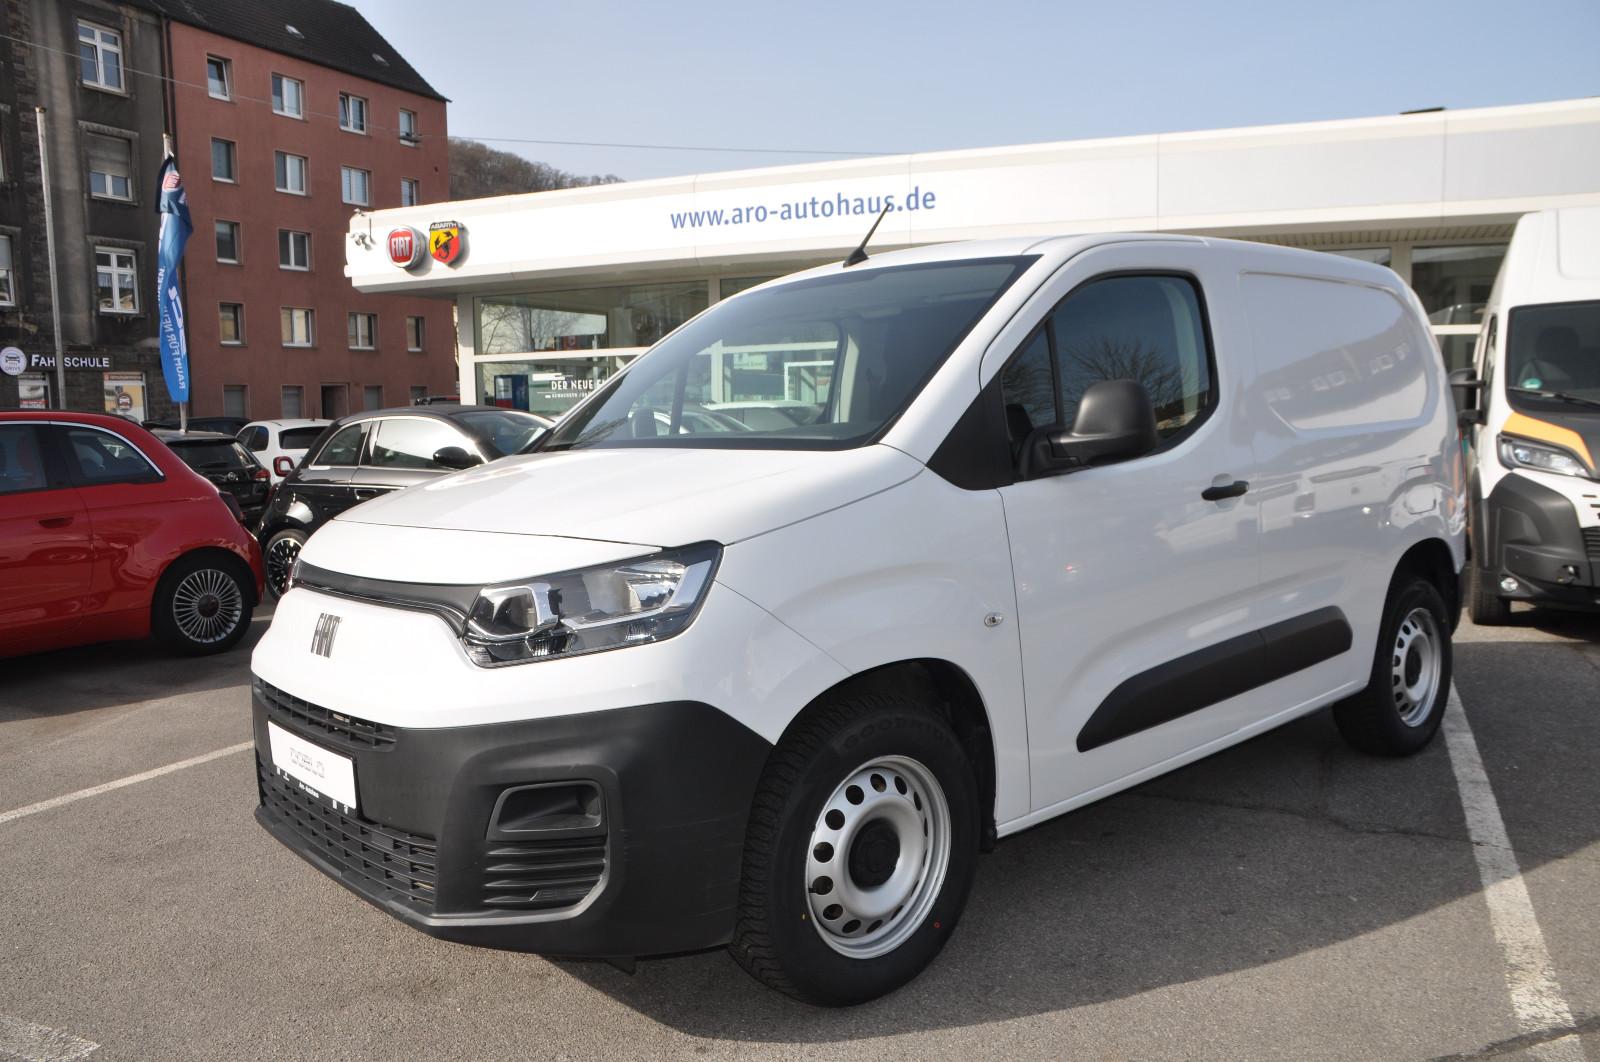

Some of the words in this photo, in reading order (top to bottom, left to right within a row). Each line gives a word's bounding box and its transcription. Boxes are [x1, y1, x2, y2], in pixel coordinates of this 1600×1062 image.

[671, 186, 936, 229] www.aro-autohaus.de
[391, 236, 411, 257] FIAT
[31, 354, 110, 367] FAHSCHULE
[551, 380, 568, 391] DER
[571, 380, 593, 390] NEUE
